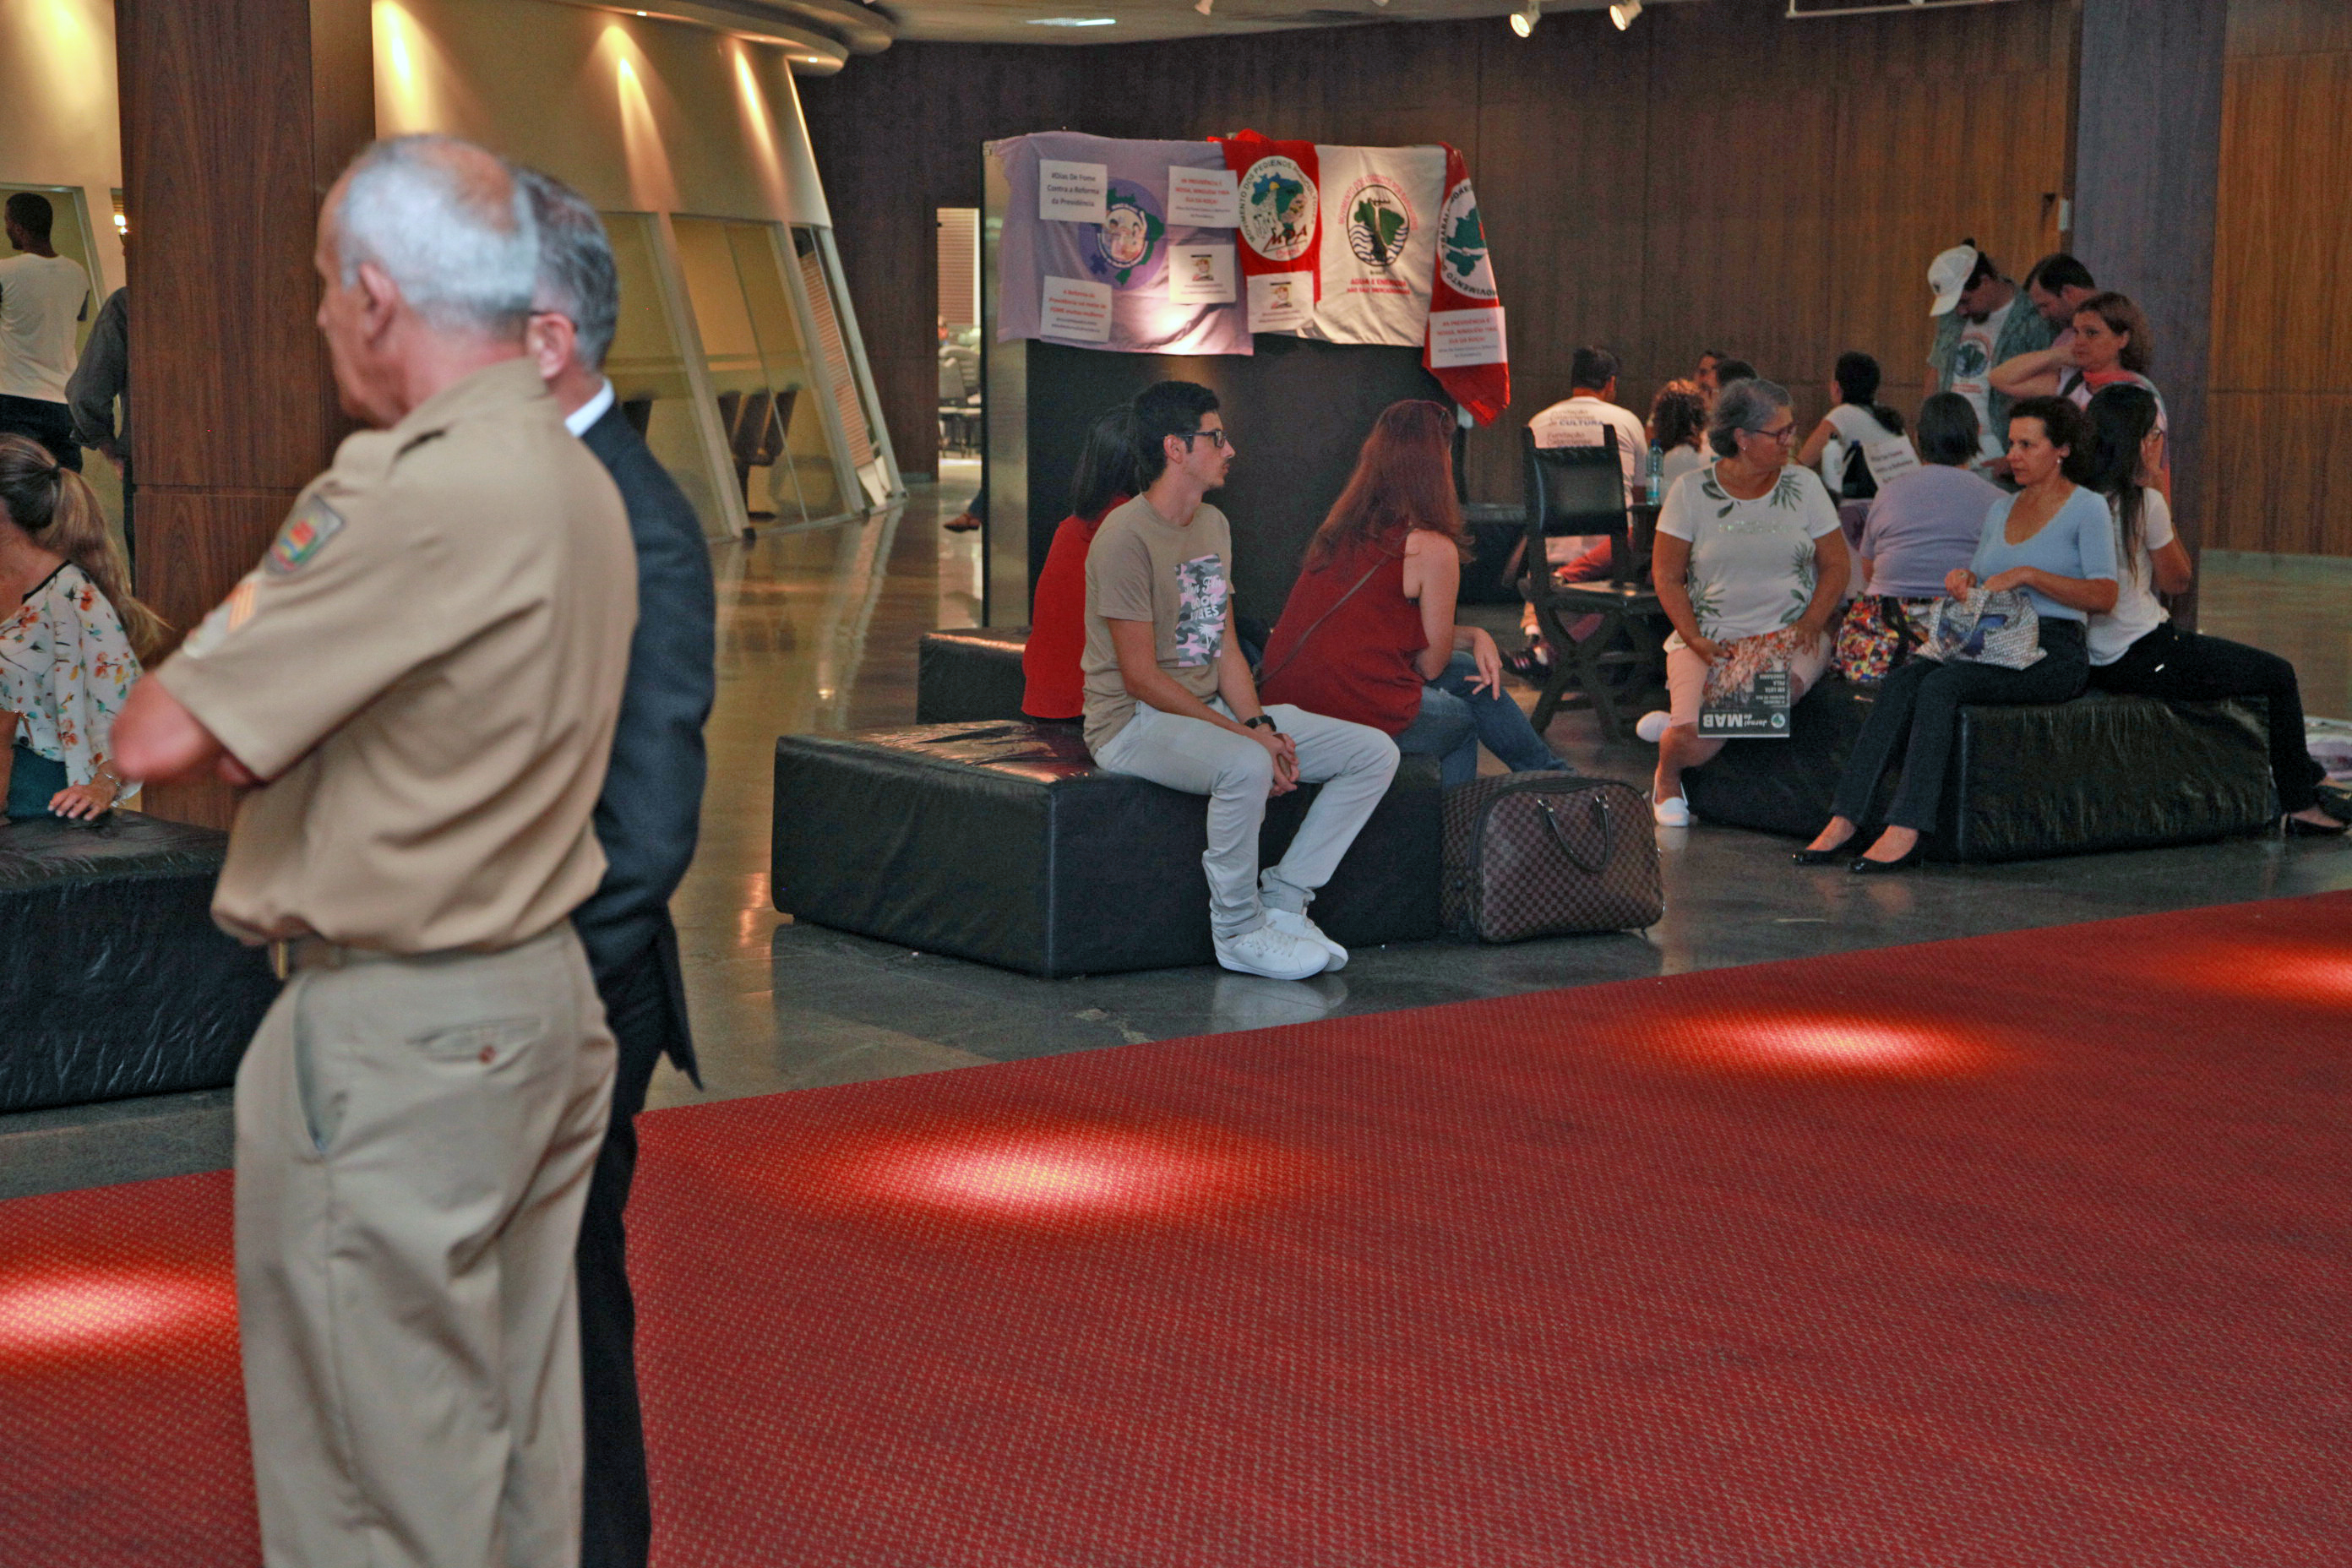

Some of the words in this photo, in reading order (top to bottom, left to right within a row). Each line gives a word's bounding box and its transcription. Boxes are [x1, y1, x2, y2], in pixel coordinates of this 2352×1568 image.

[1244, 173, 1255, 190] DOS
[1048, 184, 1068, 193] Contra
[1075, 186, 1100, 195] Reforma
[1060, 198, 1095, 208] Previdência
[1239, 192, 1255, 242] MOVIMENTO
[1191, 594, 1218, 610] GOOD
[1190, 605, 1220, 621] VIBES
[1702, 714, 1743, 727] MAB
[1744, 719, 1767, 727] Jornal
